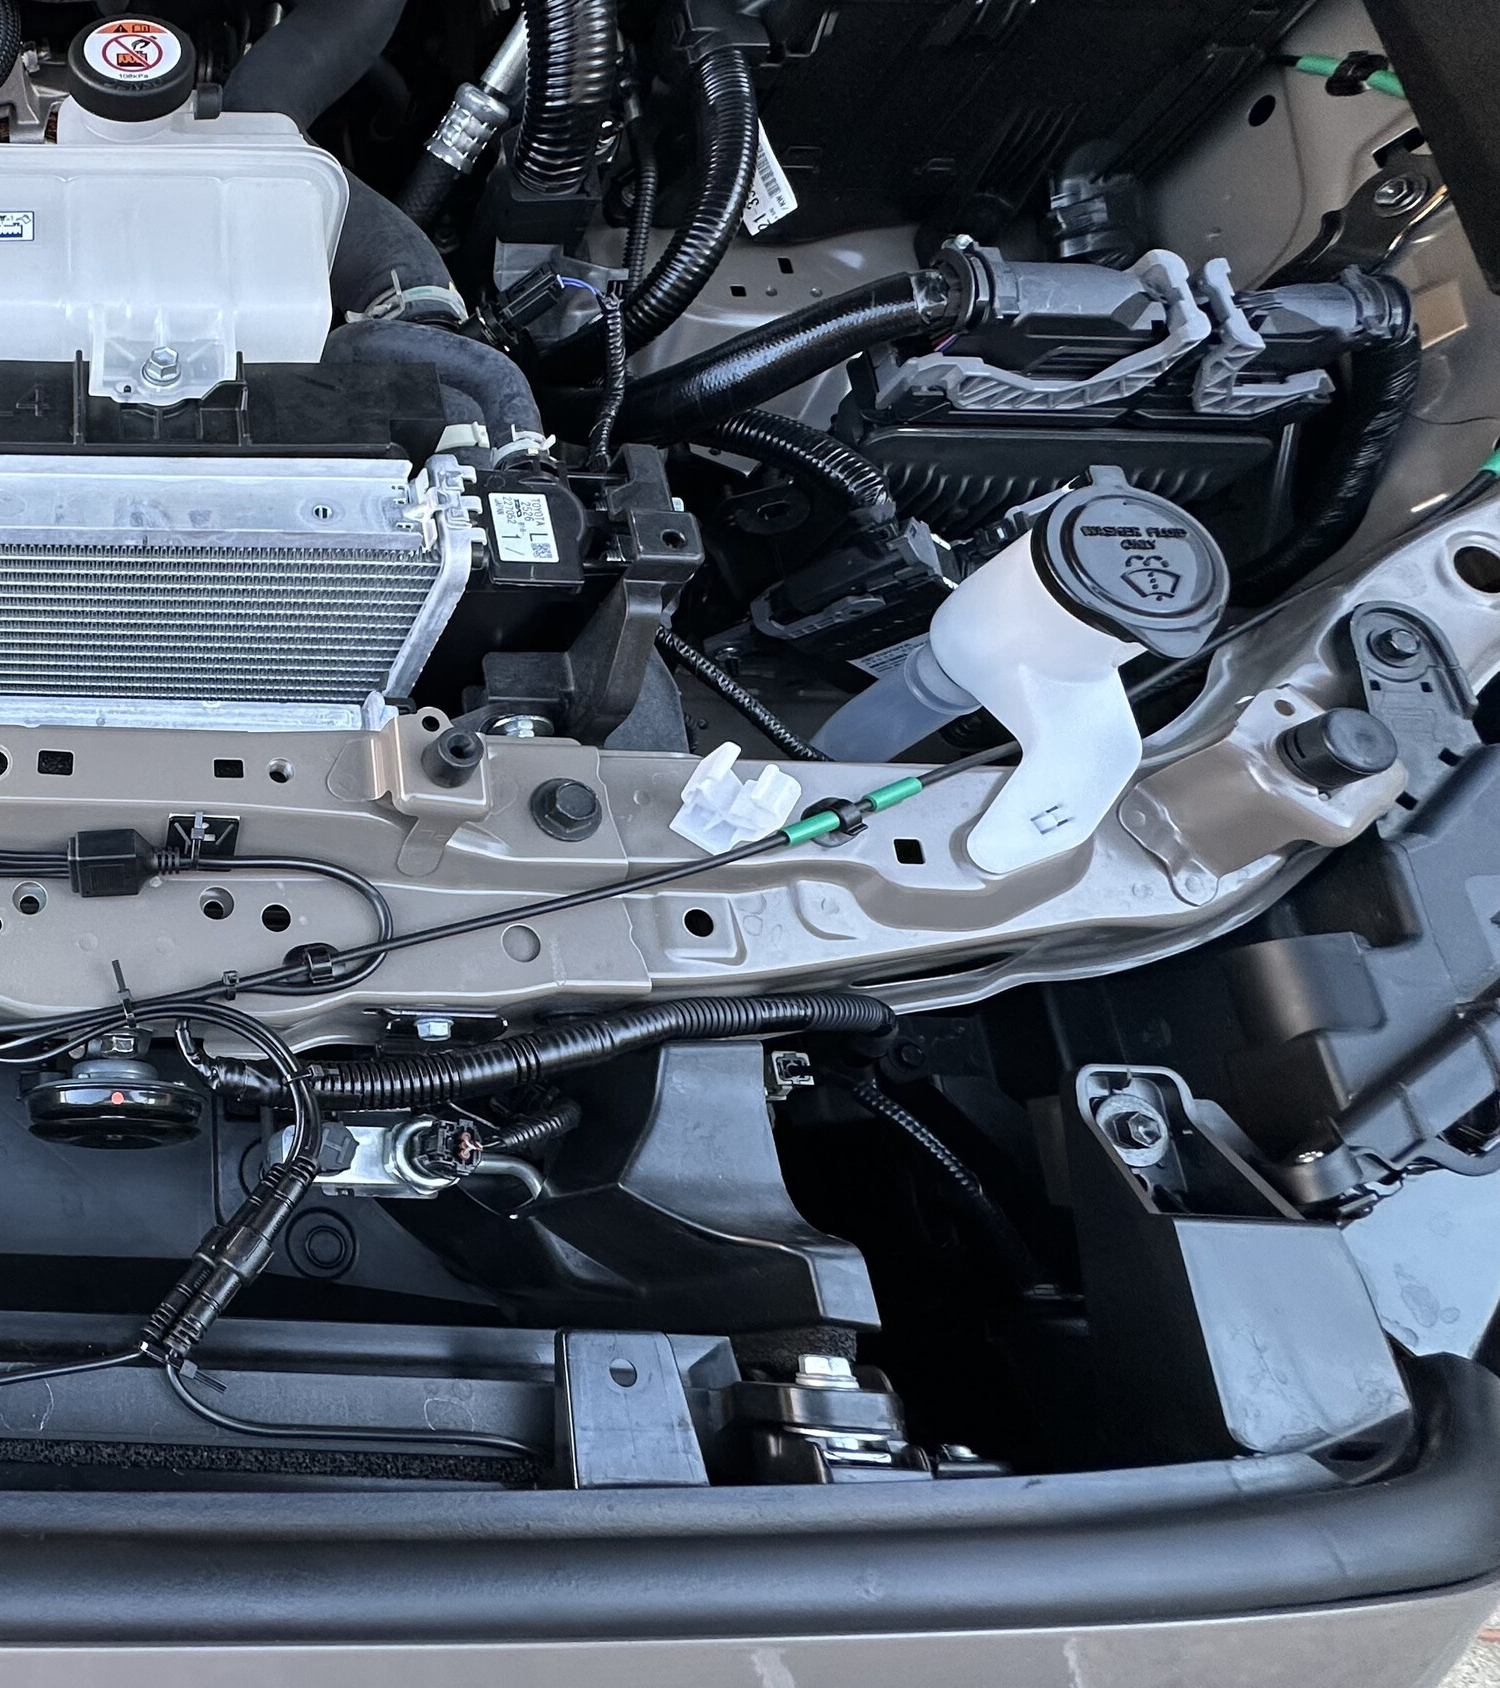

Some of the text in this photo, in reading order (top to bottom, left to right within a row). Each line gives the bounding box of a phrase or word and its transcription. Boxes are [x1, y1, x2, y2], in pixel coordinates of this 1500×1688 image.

[521, 501, 535, 522] 2526
[531, 498, 546, 527] TOYOTA
[1080, 526, 1142, 537] WASHER
[529, 533, 549, 542] L
[1120, 539, 1156, 550] ONLY
